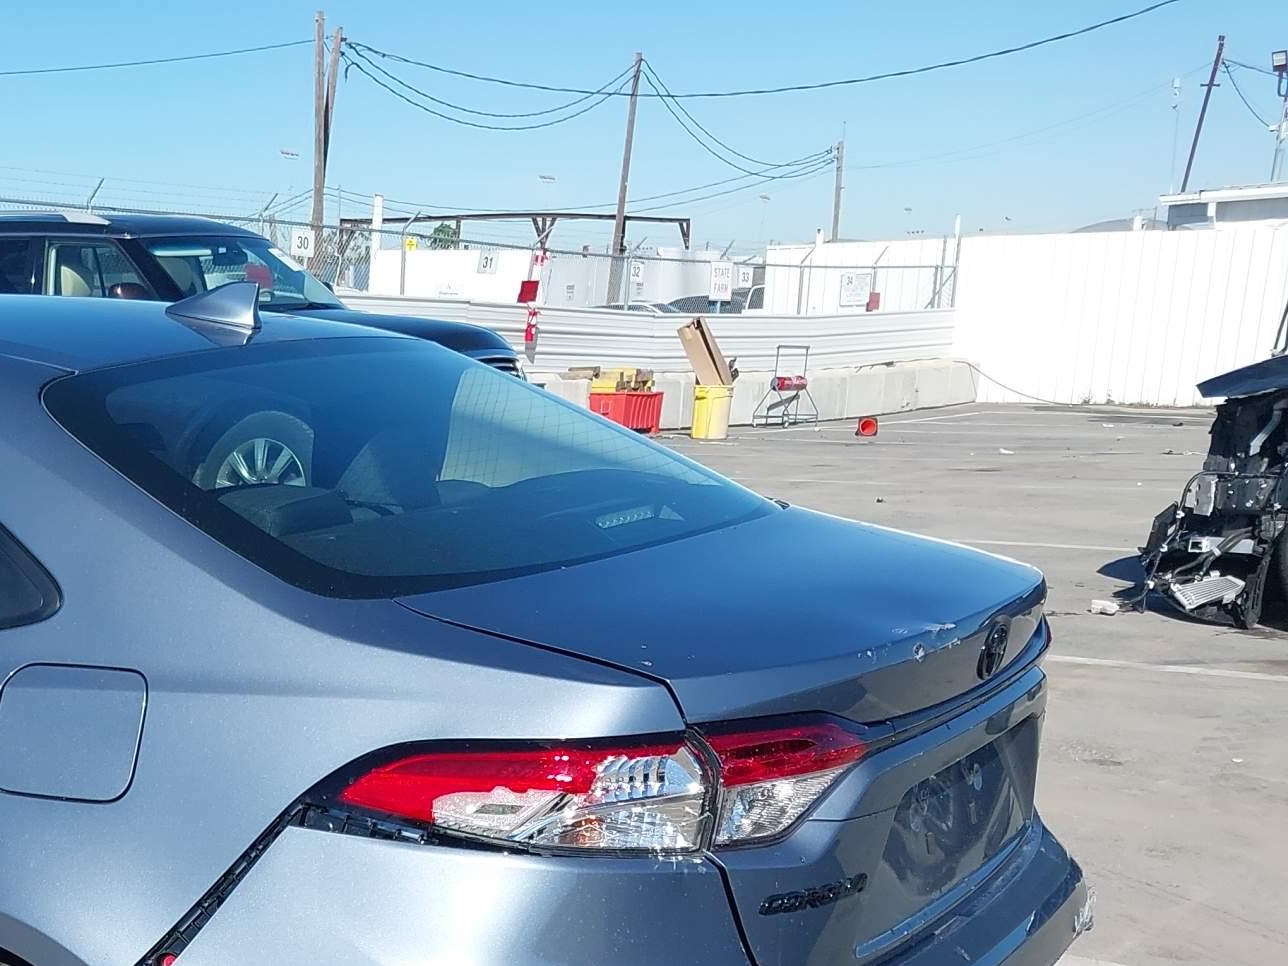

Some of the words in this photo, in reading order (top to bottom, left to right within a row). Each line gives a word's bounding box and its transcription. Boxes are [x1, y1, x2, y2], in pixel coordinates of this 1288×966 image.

[297, 235, 309, 250] 30
[483, 256, 493, 269] 31
[632, 266, 641, 278] 32
[714, 266, 730, 279] STATE
[742, 271, 750, 282] 33
[713, 282, 729, 294] FARM
